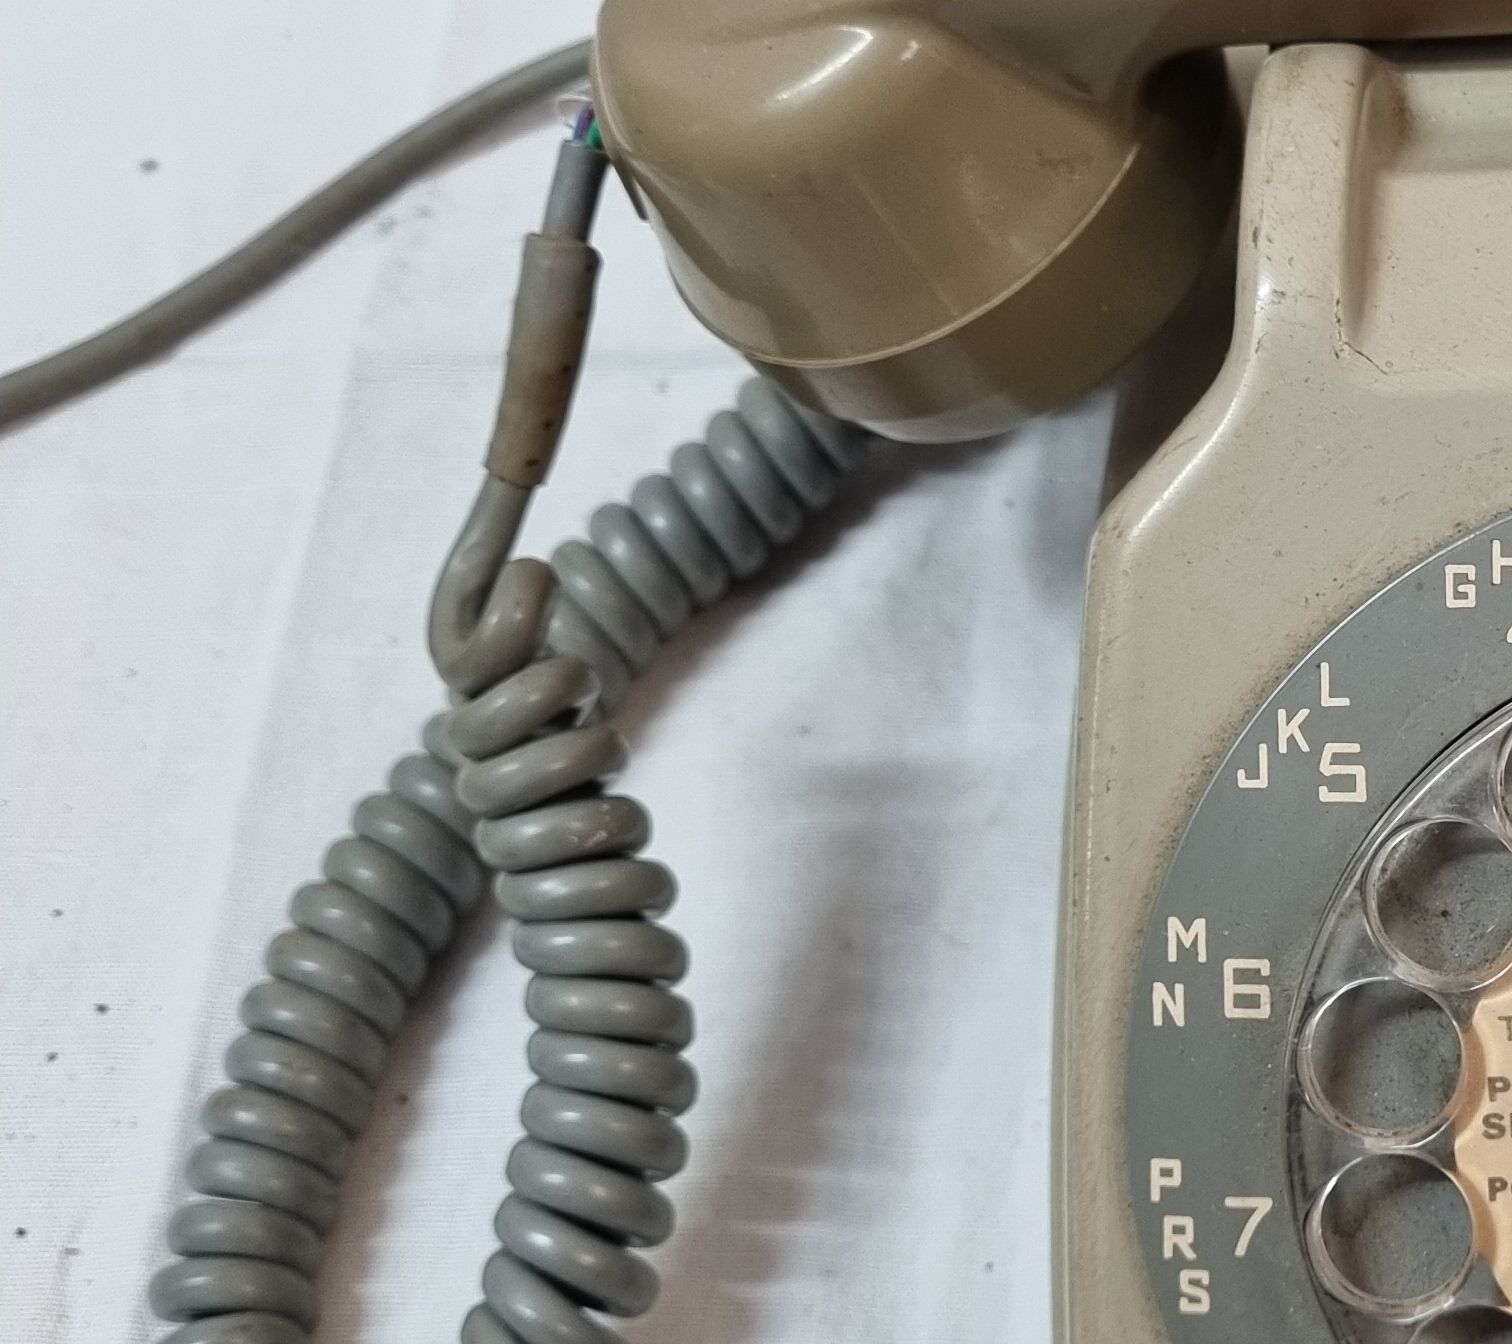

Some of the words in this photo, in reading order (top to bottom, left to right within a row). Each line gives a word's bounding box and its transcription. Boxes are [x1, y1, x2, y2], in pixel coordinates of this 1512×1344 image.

[1318, 742, 1368, 803] 5
[1222, 957, 1273, 1020] 6
[1223, 1195, 1274, 1257] 7
